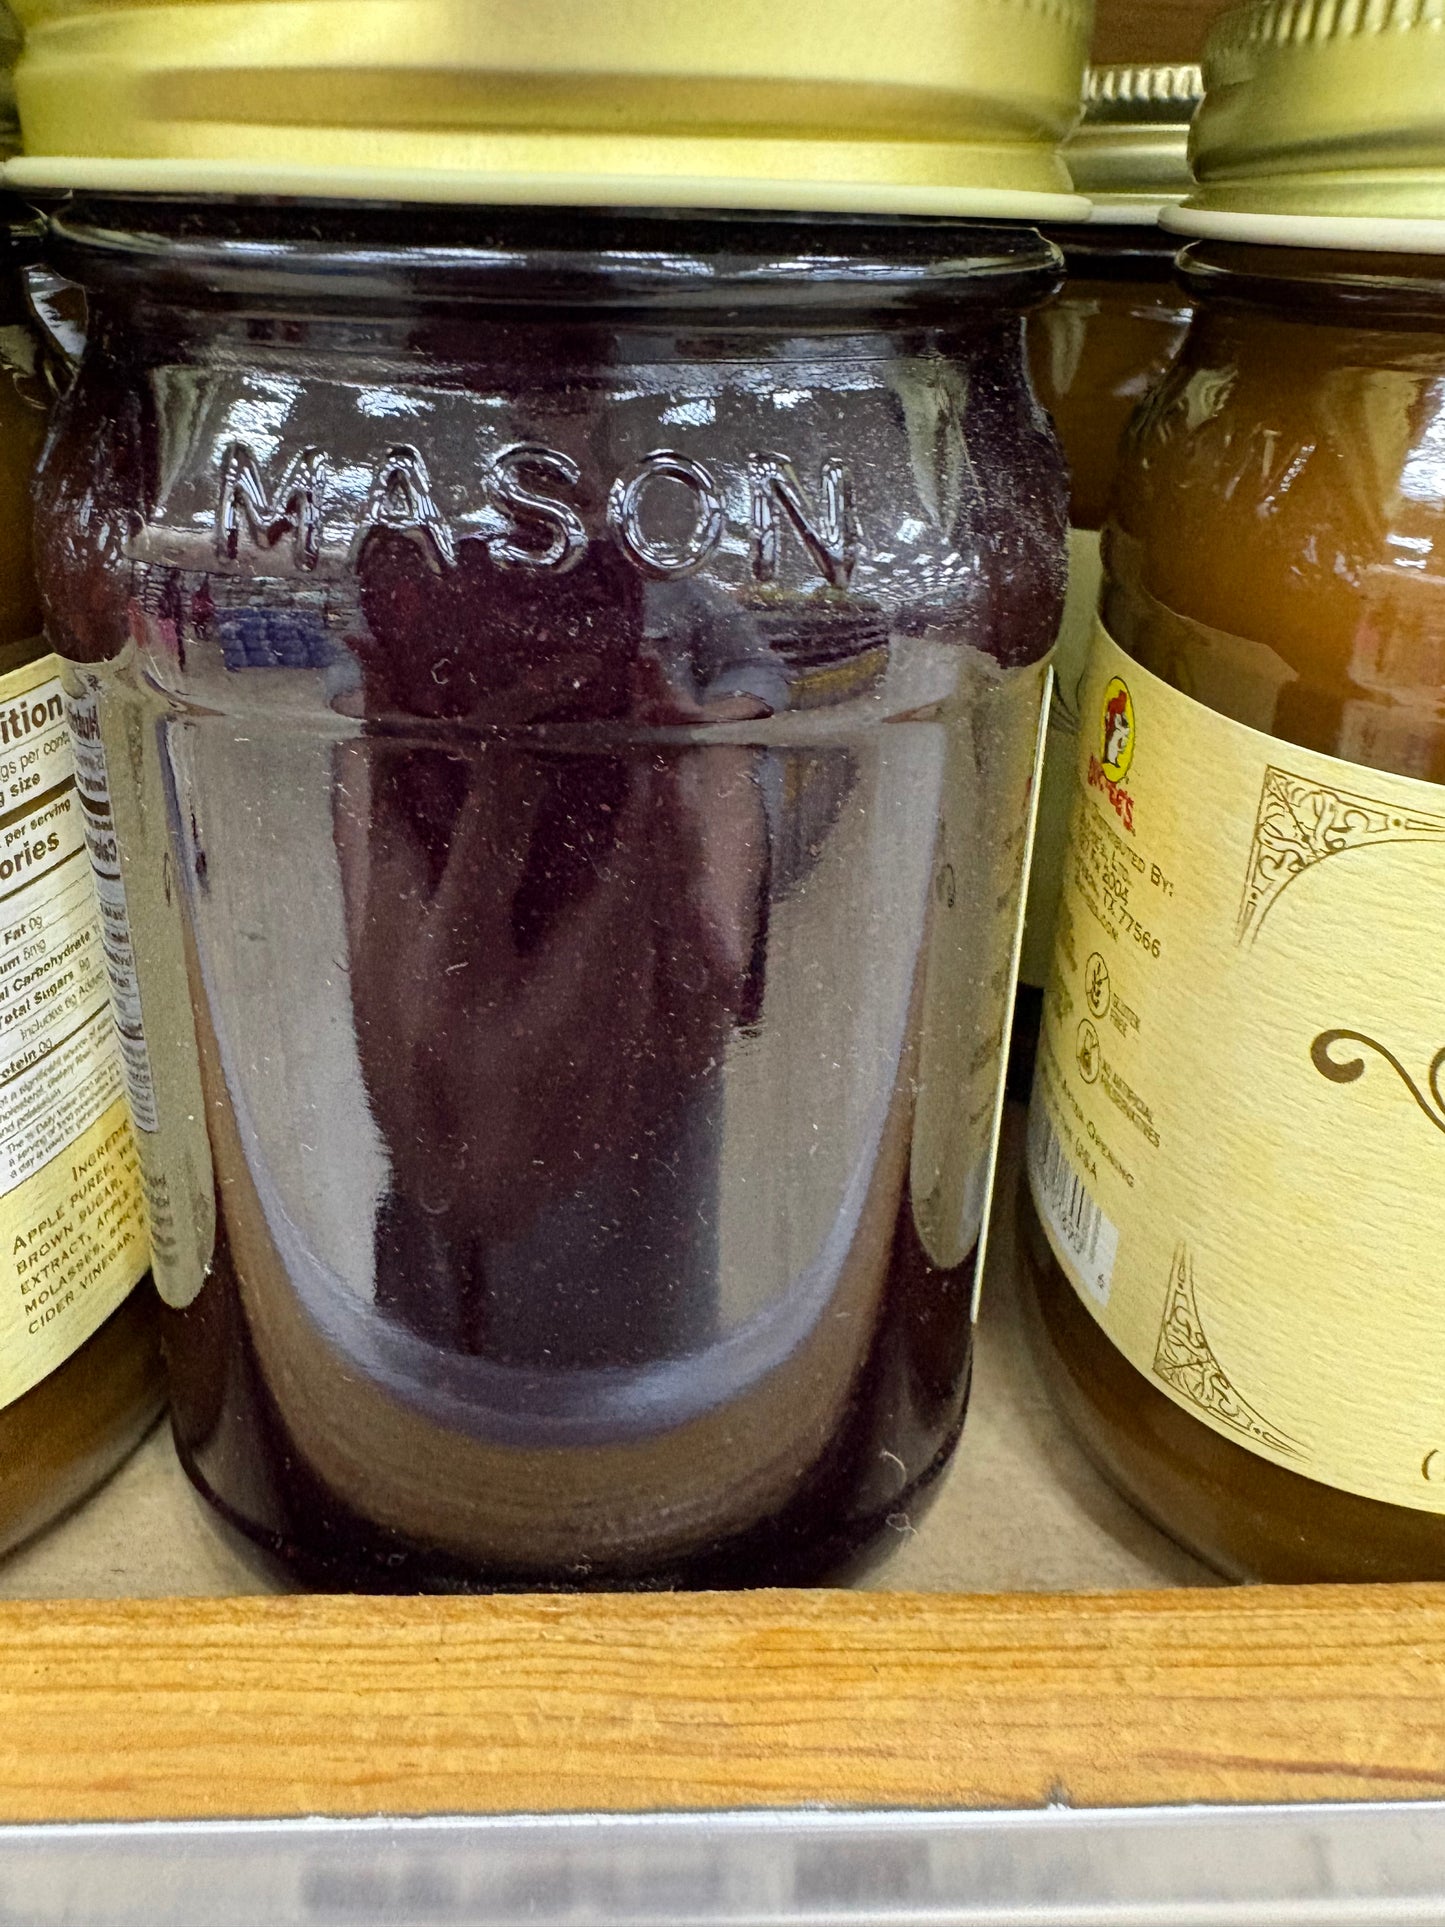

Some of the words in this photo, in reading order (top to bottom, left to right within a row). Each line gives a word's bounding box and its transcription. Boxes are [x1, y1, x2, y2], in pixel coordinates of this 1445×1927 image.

[213, 438, 857, 591] MASON
[10, 773, 40, 797] size
[20, 748, 39, 773] per
[4, 824, 26, 847] per
[30, 798, 71, 830] serving
[4, 923, 27, 945] Fat
[1118, 905, 1162, 959] 77566
[13, 931, 90, 992] Carbohydrate
[33, 970, 74, 1005] Sugars
[13, 1205, 65, 1256] APPLE
[16, 1222, 74, 1276] BROWN
[79, 1177, 123, 1224] SUGAR,
[20, 1231, 92, 1295] EXTRACT,
[24, 1242, 105, 1316] MOLASSES,
[28, 1290, 74, 1334] CIDER
[79, 1232, 136, 1290] VINEGAR,
